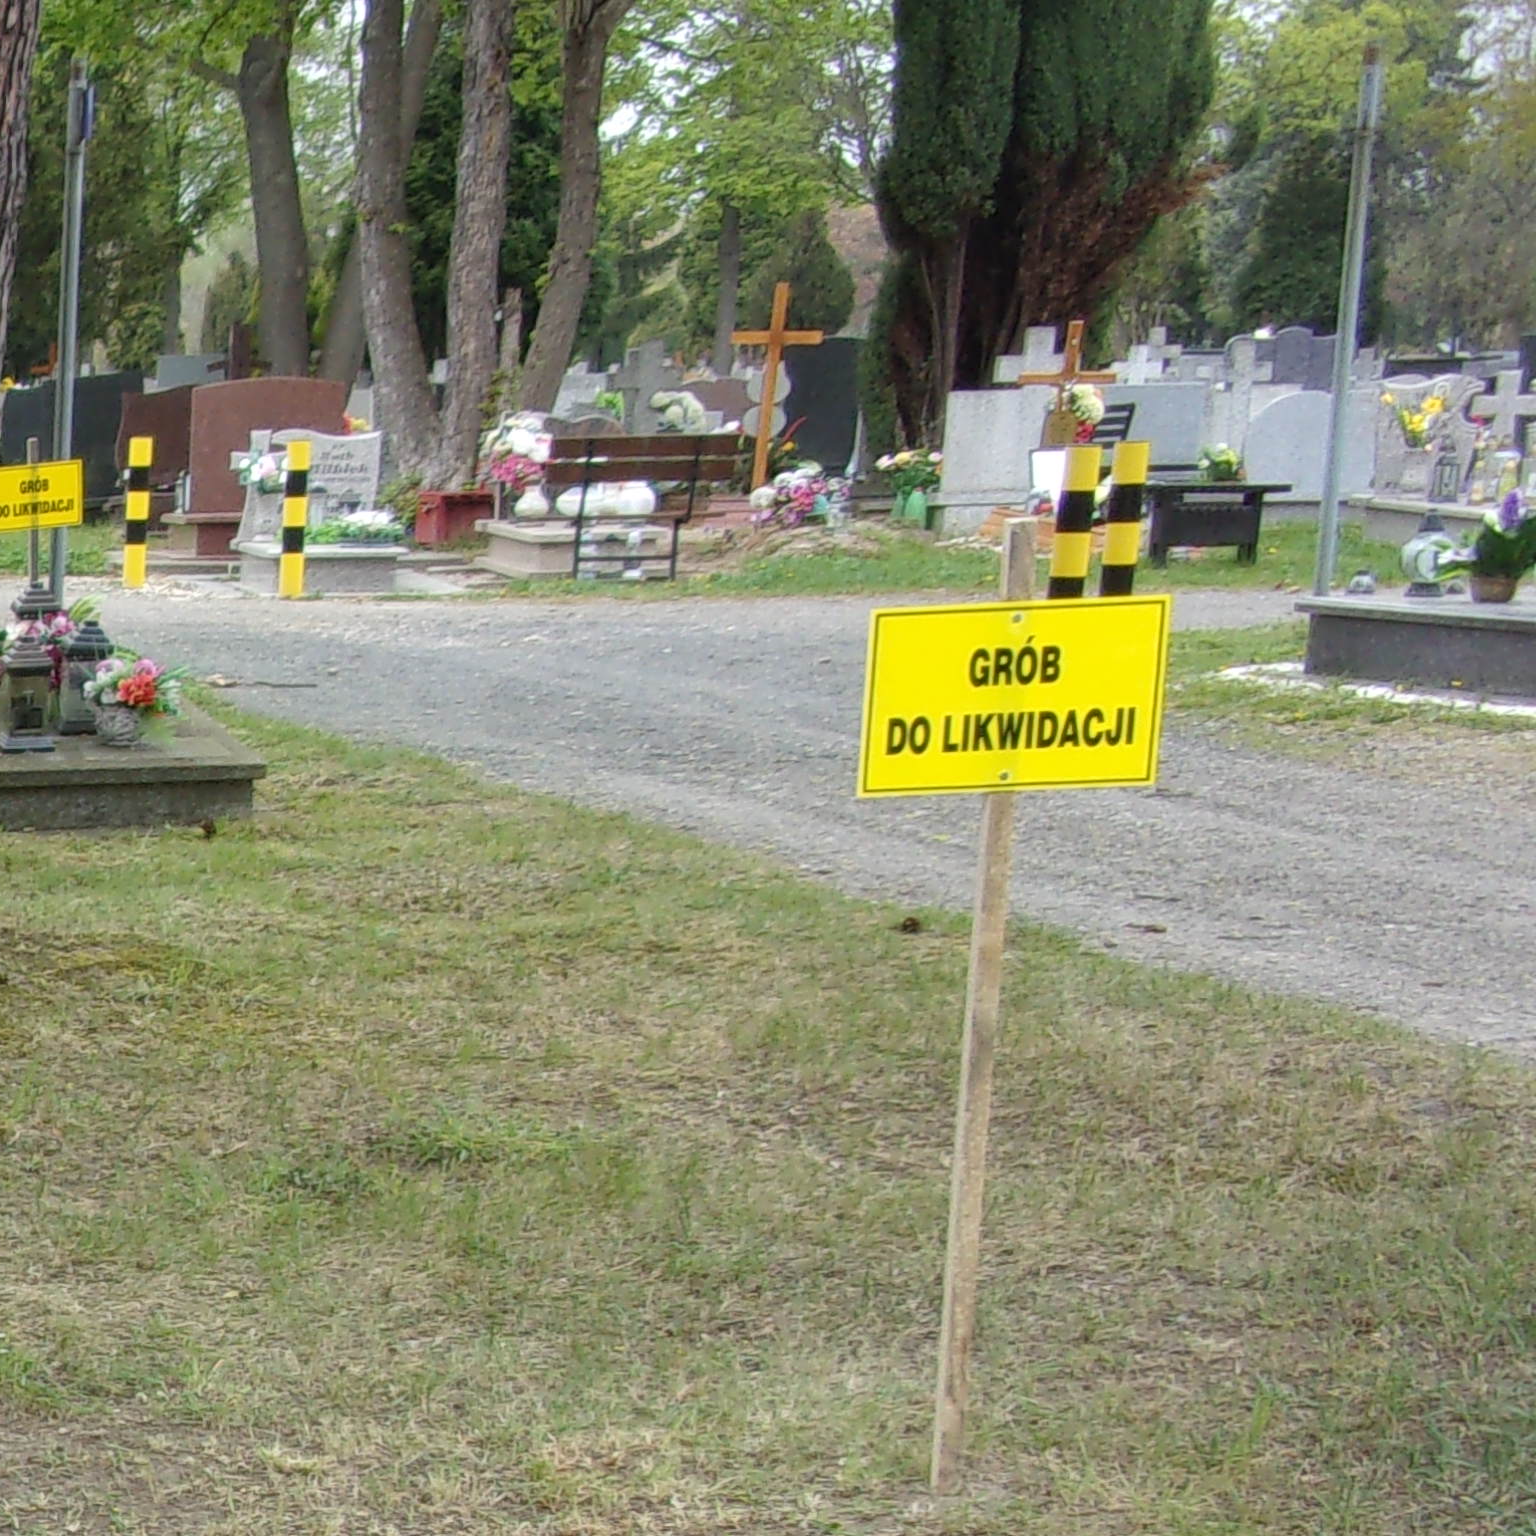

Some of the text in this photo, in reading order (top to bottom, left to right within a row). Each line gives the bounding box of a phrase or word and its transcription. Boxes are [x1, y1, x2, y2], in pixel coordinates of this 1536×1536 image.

[19, 475, 49, 494] GRÓB
[13, 499, 74, 517] LIKWIDACJI
[970, 636, 1061, 686] GRÓB
[886, 707, 1135, 755] DO LIKWIDACJI
